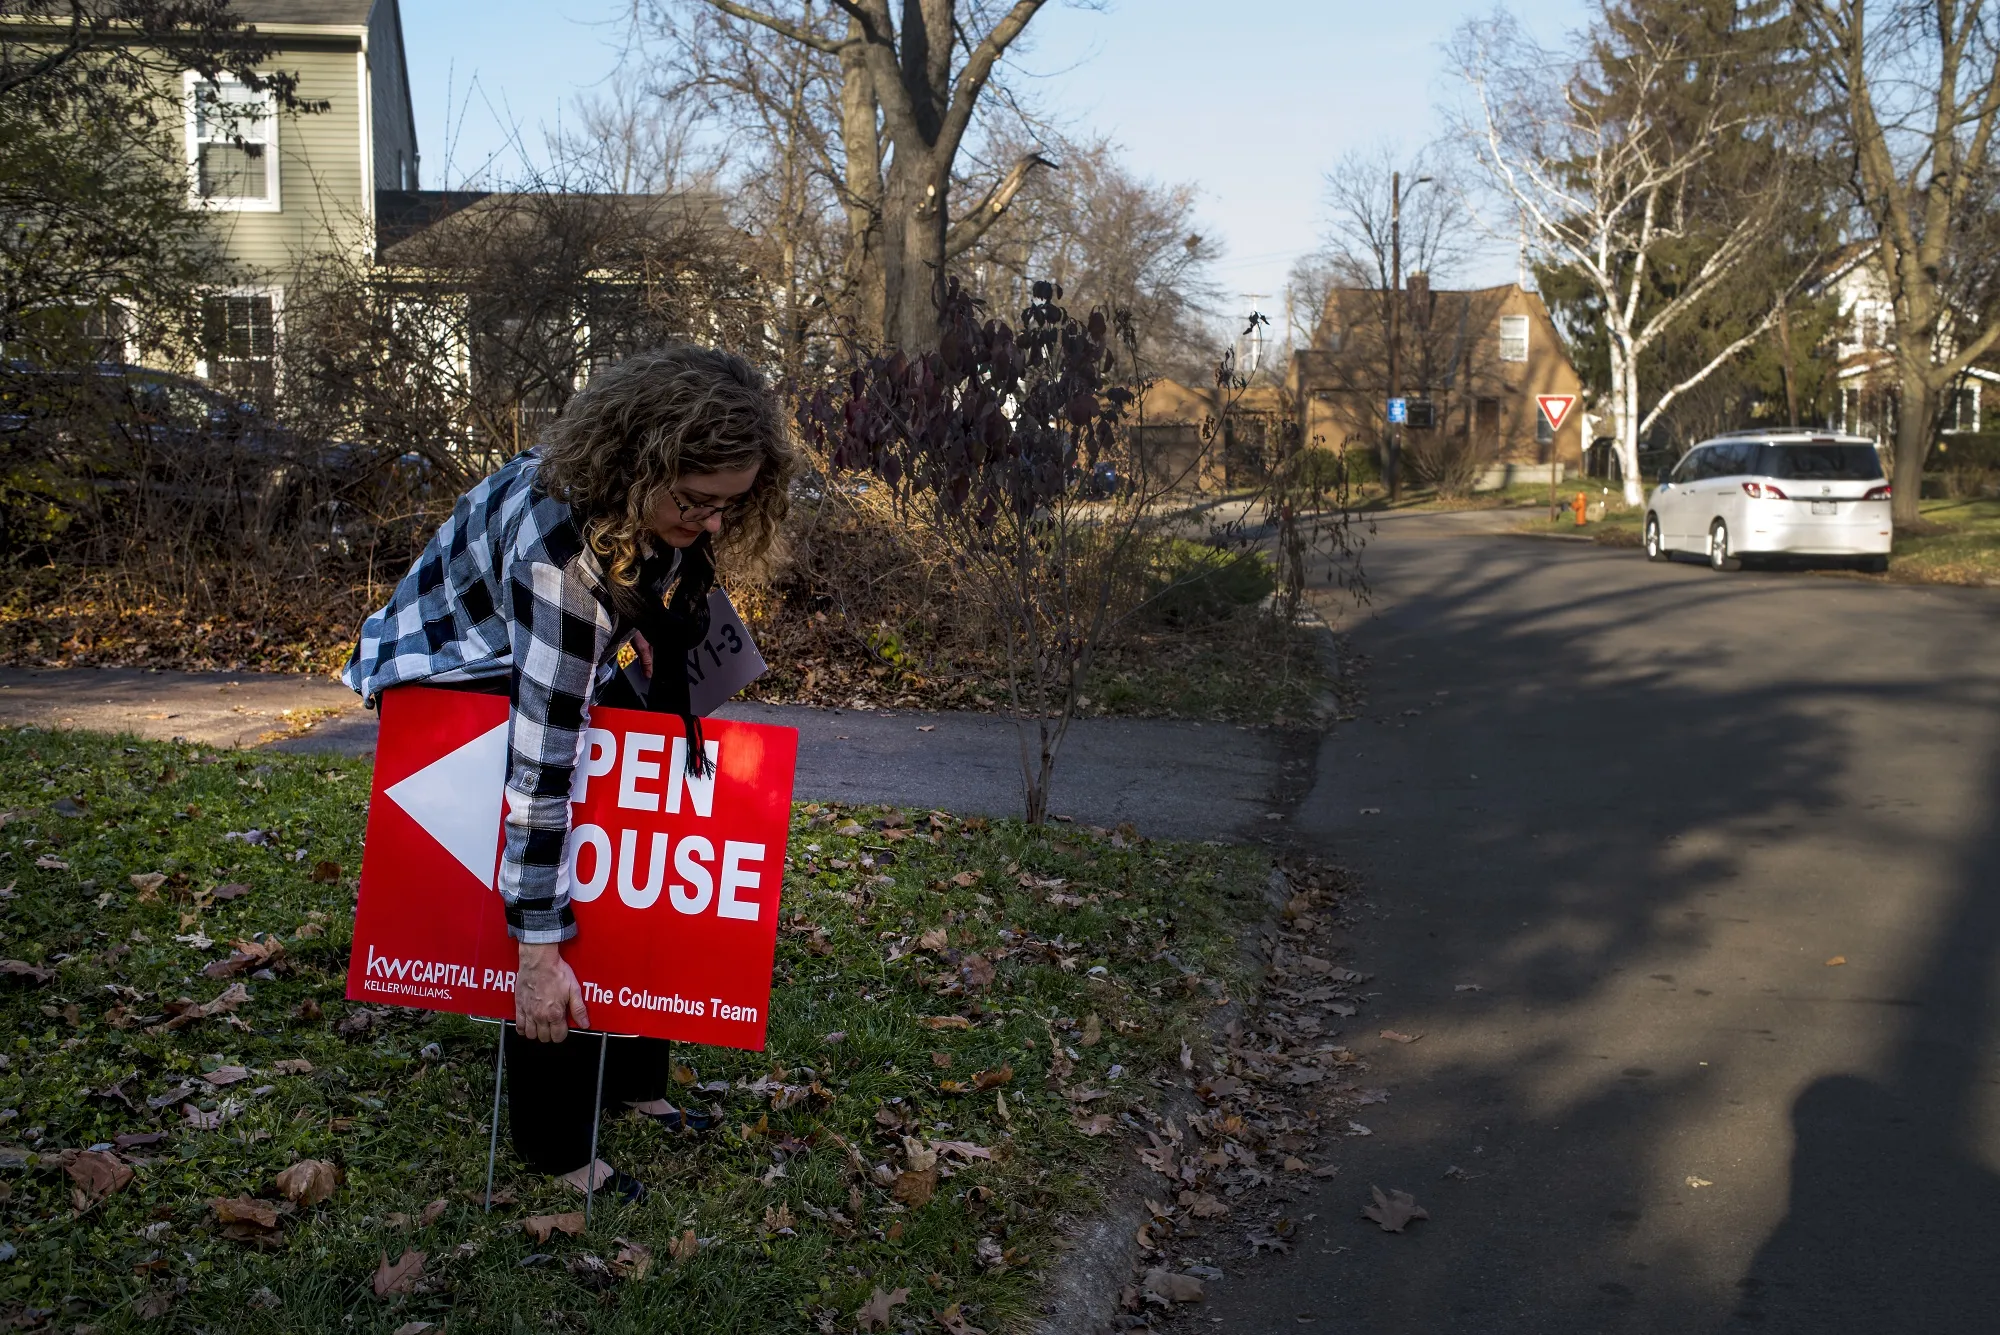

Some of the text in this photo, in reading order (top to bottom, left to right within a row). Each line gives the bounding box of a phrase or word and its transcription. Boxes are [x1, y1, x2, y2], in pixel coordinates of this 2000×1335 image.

[687, 623, 743, 686] Y 1-3
[571, 727, 719, 818] PEN
[569, 823, 766, 921] OUSE
[366, 944, 519, 993] kw CAPITAL PAR
[582, 981, 758, 1023] The Columbus Team
